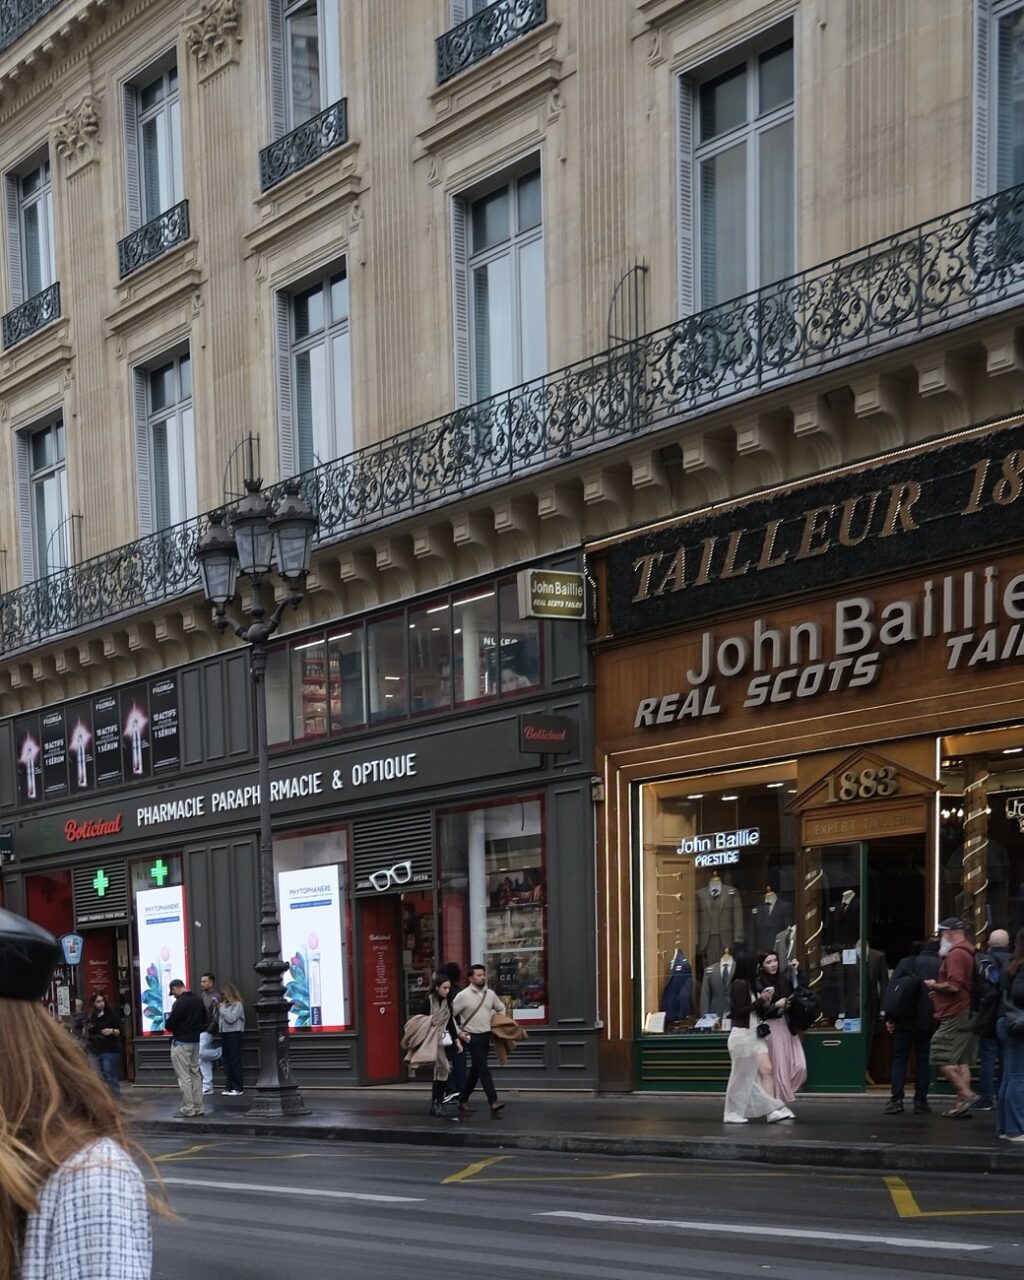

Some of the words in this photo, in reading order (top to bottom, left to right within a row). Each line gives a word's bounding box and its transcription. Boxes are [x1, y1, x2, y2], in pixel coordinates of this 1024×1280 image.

[631, 481, 922, 603] TAILLEUR
[532, 580, 554, 594] John
[555, 582, 583, 597] Baillie
[686, 619, 823, 685] John
[835, 566, 1024, 656] Baillie
[633, 684, 721, 729] REAL
[743, 652, 879, 709] SCOTS
[137, 796, 205, 827] PHARMACIE
[211, 772, 323, 812] PARAPHRMACIE
[332, 769, 344, 790] &
[351, 753, 418, 786] OPTIQUE
[824, 765, 897, 803] 1883
[64, 813, 122, 843] Boticinal
[677, 835, 711, 854] John
[716, 828, 760, 849] Baillie
[814, 820, 856, 835] EXPERT
[694, 850, 741, 868] PRESTIGE
